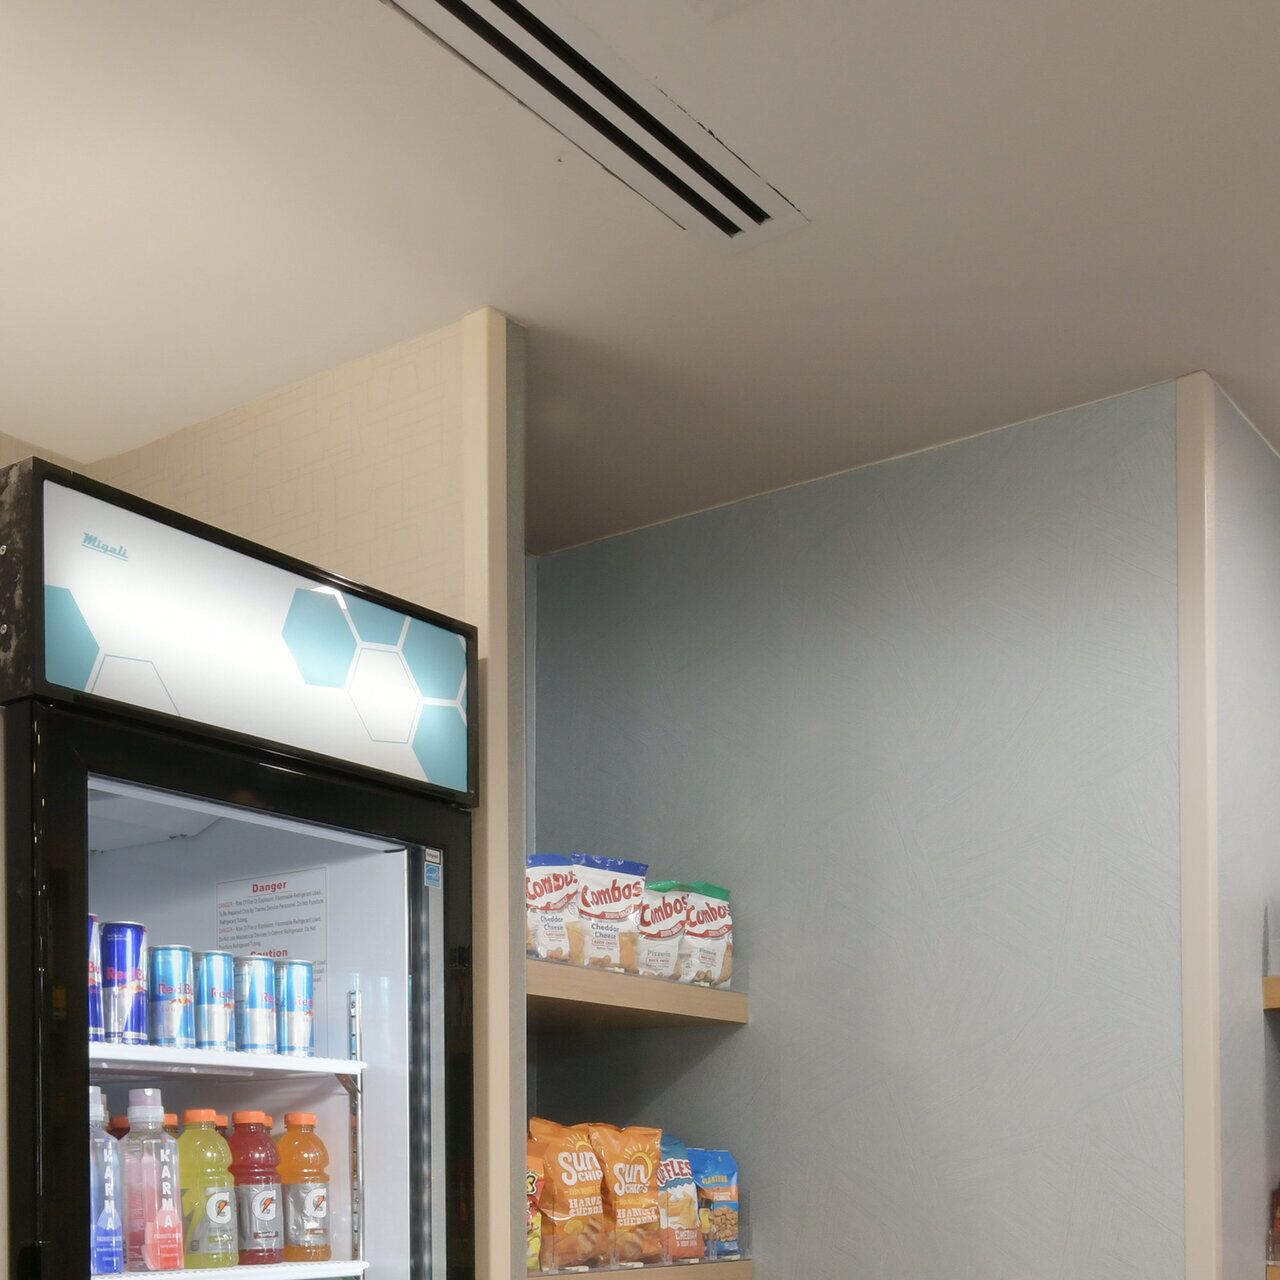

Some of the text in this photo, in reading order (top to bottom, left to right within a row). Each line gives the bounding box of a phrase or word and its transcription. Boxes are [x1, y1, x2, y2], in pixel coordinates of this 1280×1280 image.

[81, 532, 128, 557] Migali
[252, 882, 287, 893] Danger
[582, 879, 642, 908] Combos
[640, 895, 687, 927] Combos
[591, 924, 619, 932] Cheddar
[595, 931, 616, 939] Cheese
[558, 1151, 600, 1185] Sun
[614, 1163, 645, 1195] Sun
[161, 1150, 173, 1227] KARMA
[206, 1192, 231, 1223] G
[252, 1191, 277, 1220] G
